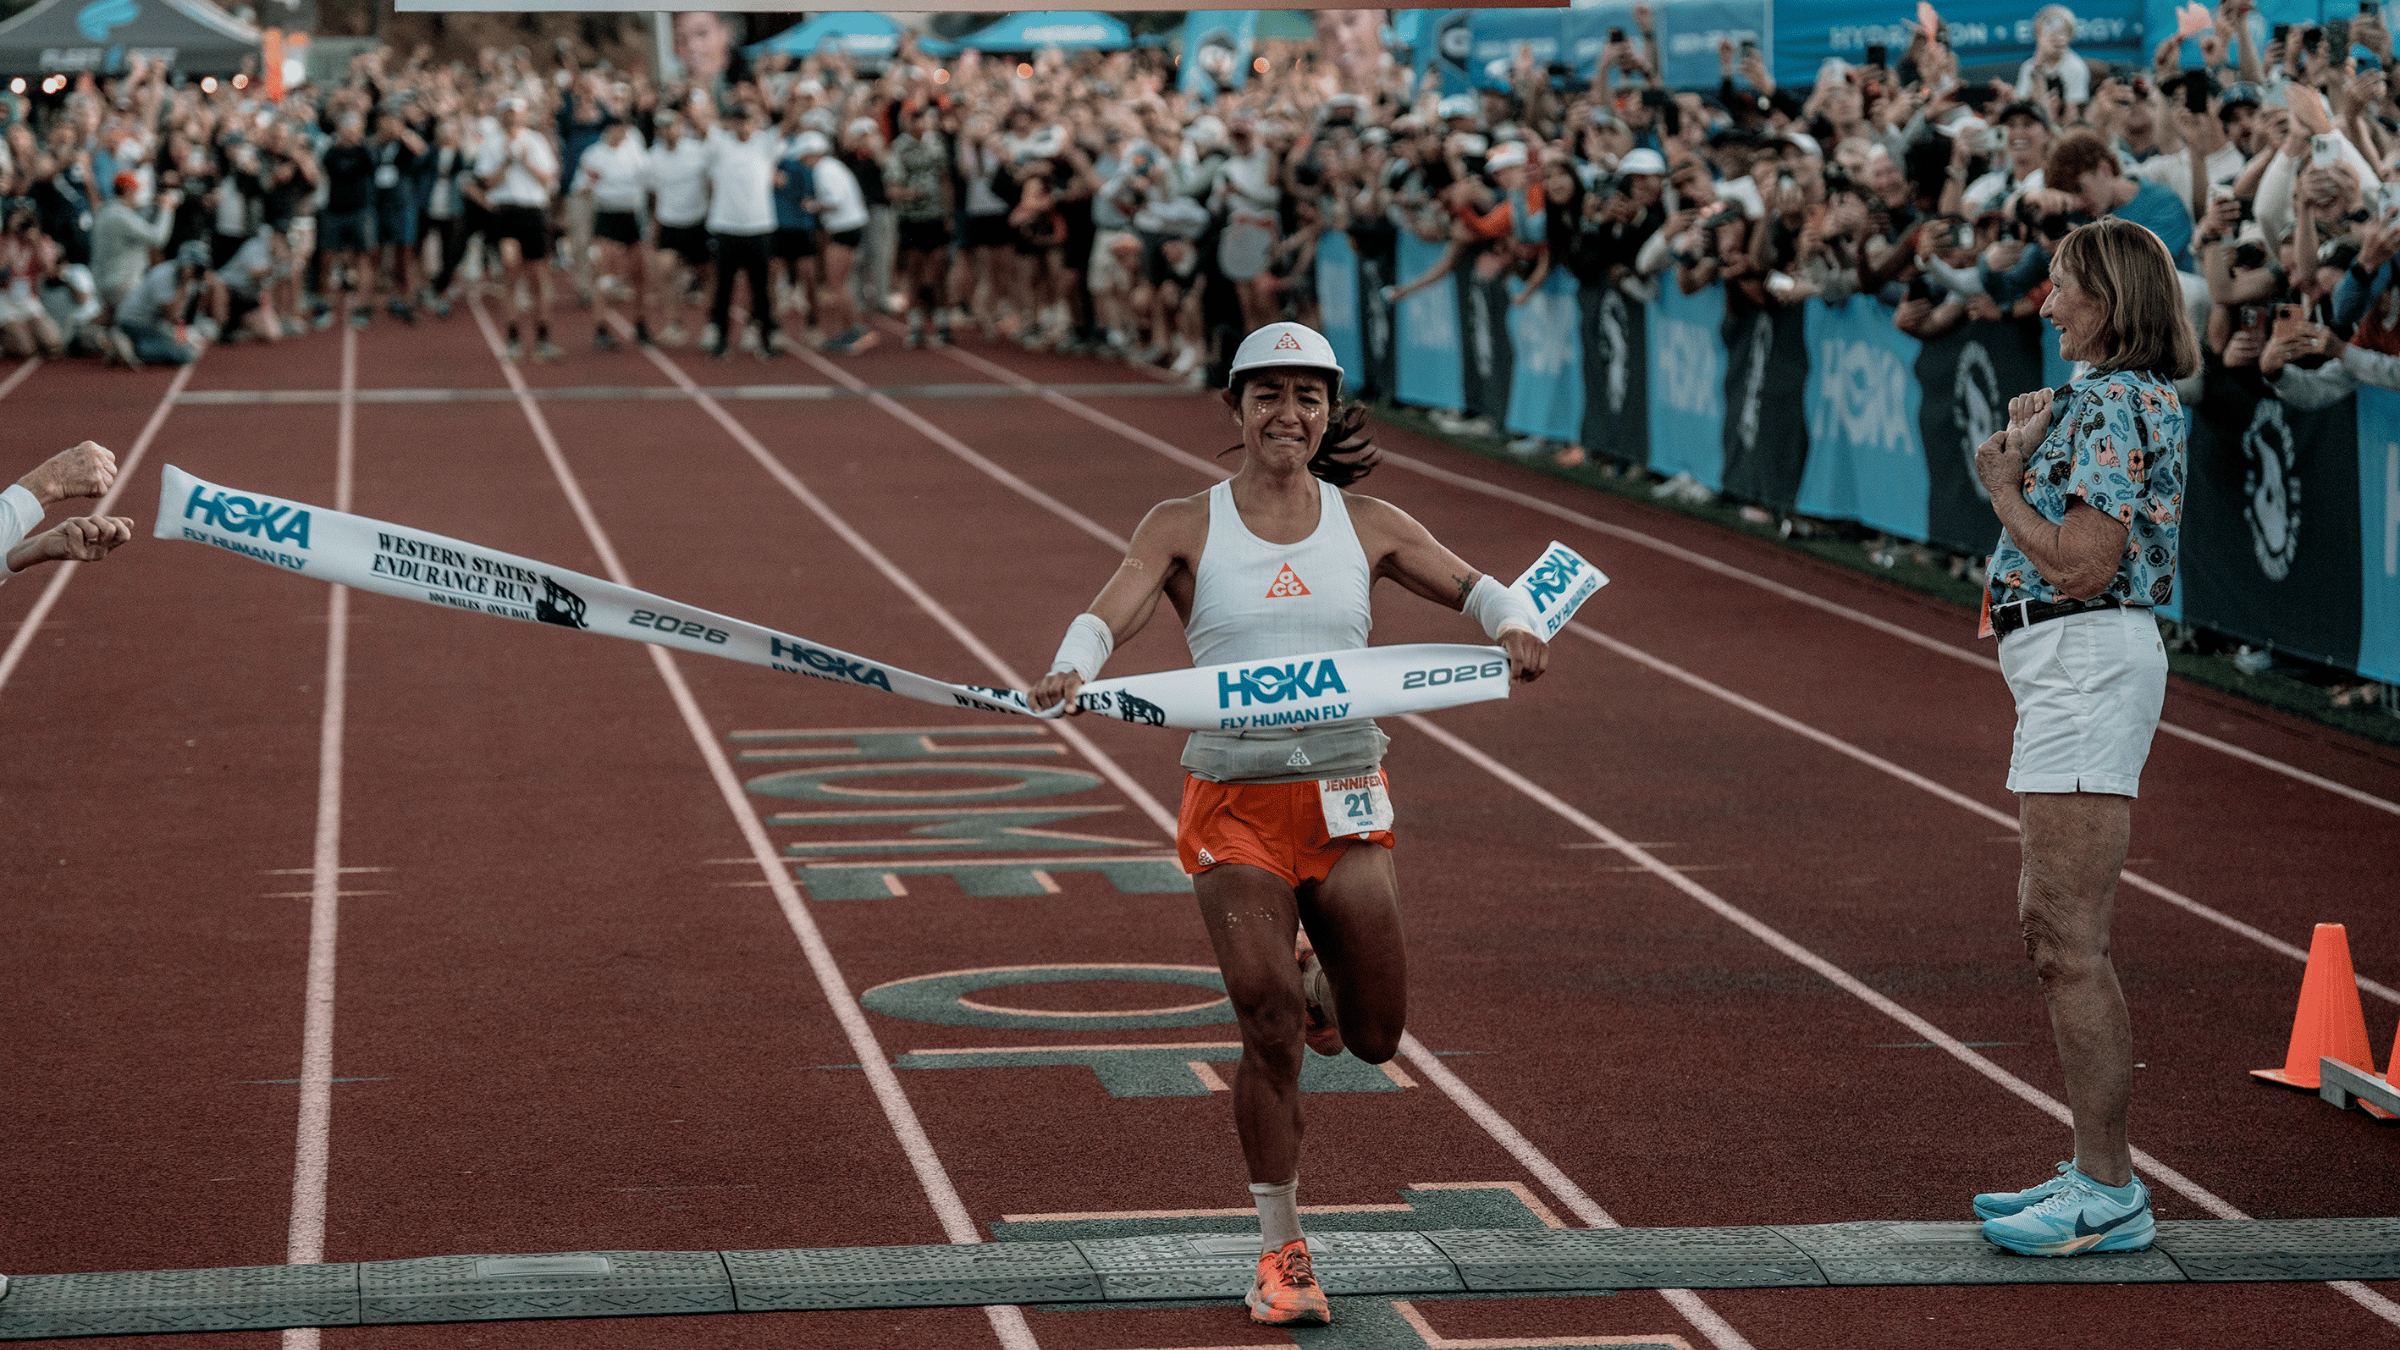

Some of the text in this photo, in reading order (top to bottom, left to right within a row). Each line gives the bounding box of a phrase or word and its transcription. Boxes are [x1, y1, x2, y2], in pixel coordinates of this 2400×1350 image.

[2014, 17, 2126, 44] ERGY
[1812, 338, 1915, 454] HOKA
[184, 484, 311, 550] HOKA
[183, 527, 307, 570] FLY HUMAN FLY
[378, 532, 537, 585] WESTERN STATES
[372, 553, 534, 603] ENDURANCE RUN
[1522, 549, 1585, 614] HOKA
[448, 595, 481, 611] MILES
[487, 602, 509, 616] ONE
[628, 609, 730, 644] 2026
[771, 637, 893, 693] HOKA
[1217, 659, 1347, 708] HOKA
[1402, 661, 1503, 690] 2026
[1077, 691, 1113, 711] TES
[1220, 702, 1351, 730] FLY HUMAN FLY
[1324, 775, 1383, 793] JENNIFER
[1344, 792, 1373, 817] 21
[727, 725, 1195, 900] HOME
[858, 963, 1420, 1098] OF
